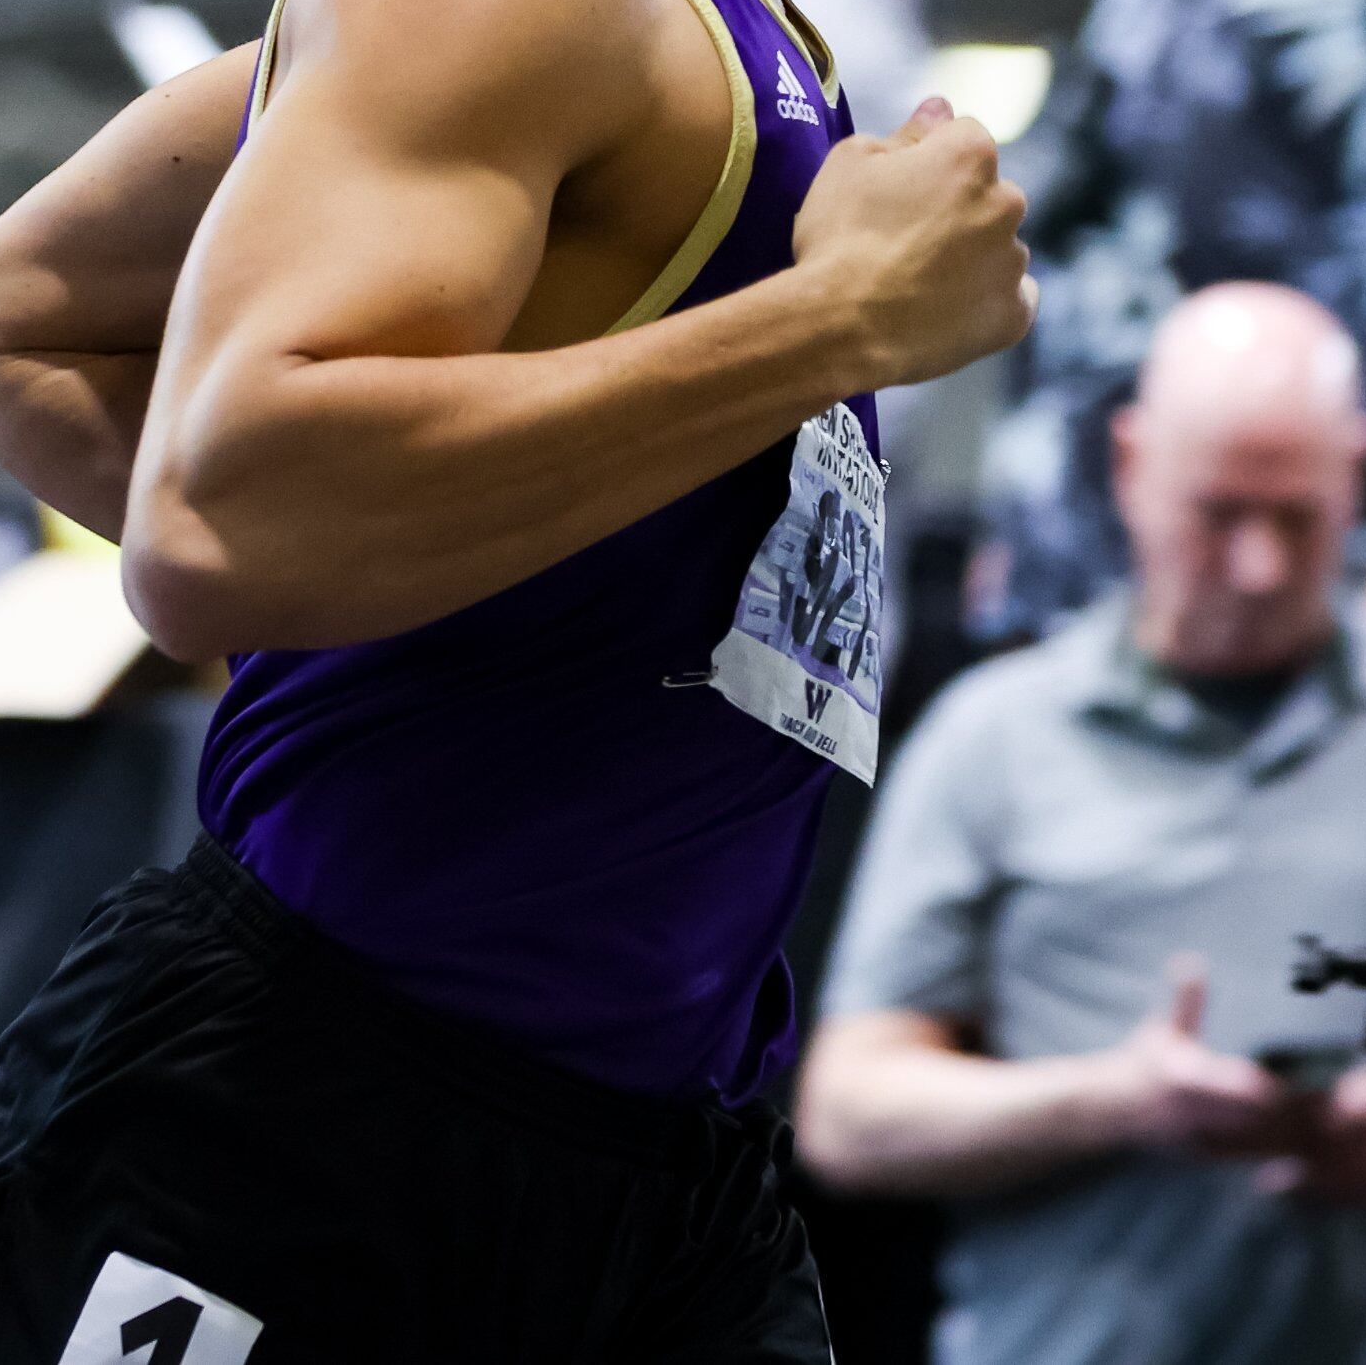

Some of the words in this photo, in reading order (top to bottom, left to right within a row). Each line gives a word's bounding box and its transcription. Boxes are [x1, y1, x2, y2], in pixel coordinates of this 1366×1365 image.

[776, 93, 819, 126] adidas
[805, 678, 833, 724] W
[120, 1295, 205, 1365] 1
